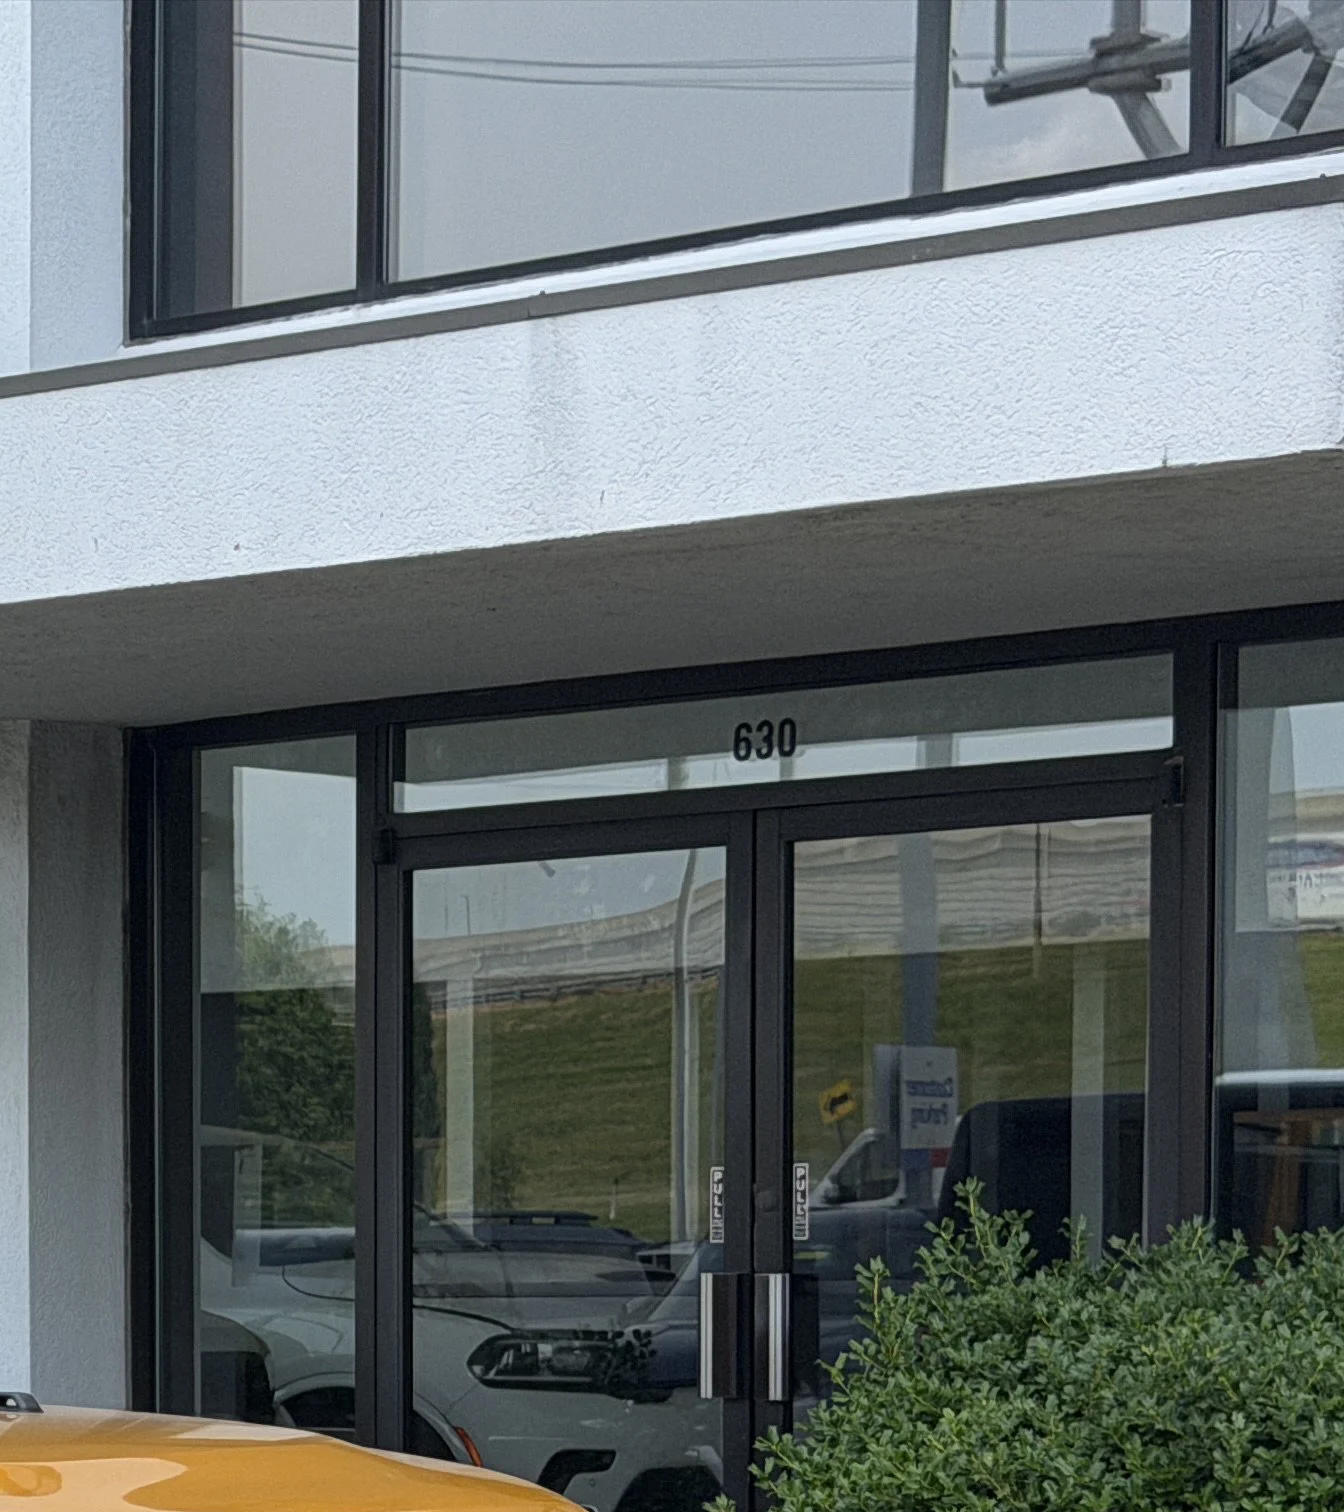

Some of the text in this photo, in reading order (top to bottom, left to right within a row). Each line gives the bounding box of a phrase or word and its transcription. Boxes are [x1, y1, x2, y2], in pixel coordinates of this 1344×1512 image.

[733, 717, 797, 762] 630
[714, 1171, 723, 1218] PULL
[796, 1167, 806, 1215] PULL
